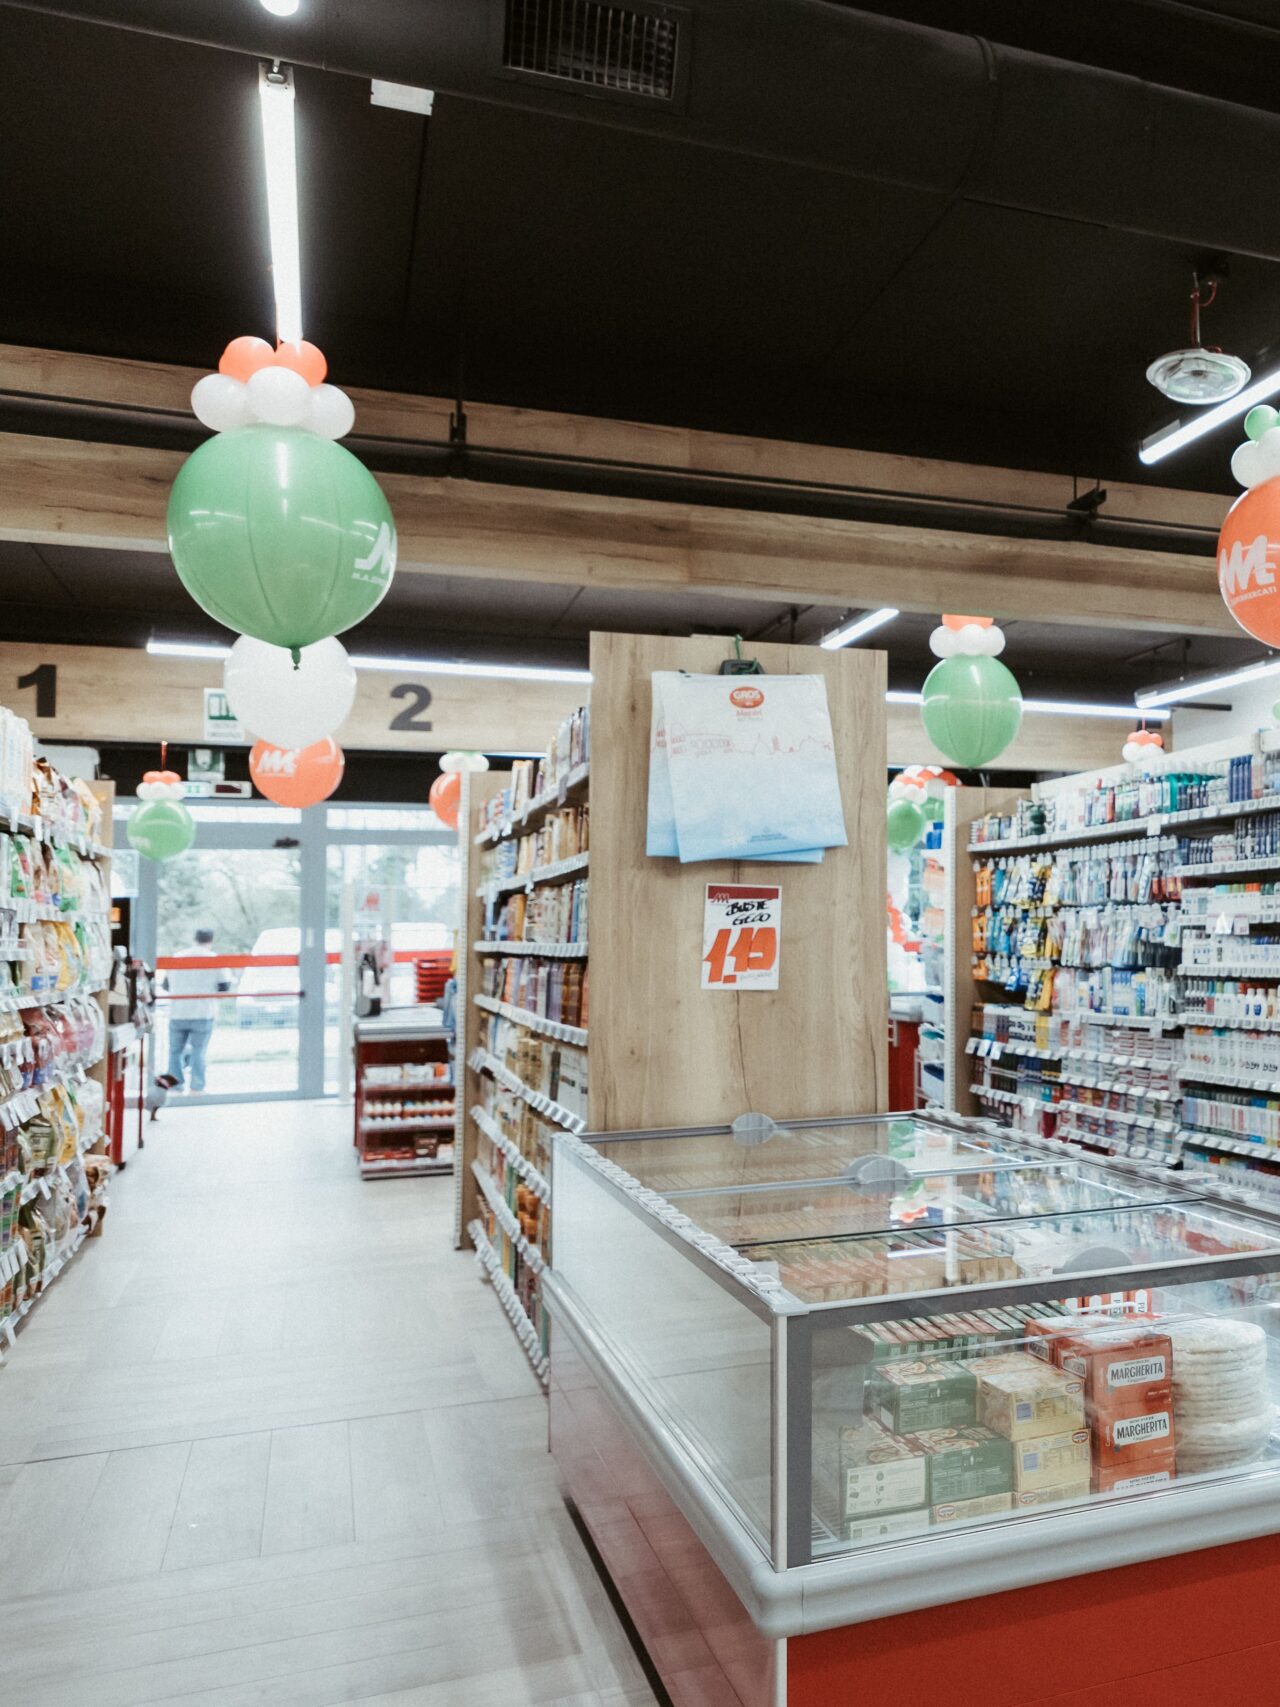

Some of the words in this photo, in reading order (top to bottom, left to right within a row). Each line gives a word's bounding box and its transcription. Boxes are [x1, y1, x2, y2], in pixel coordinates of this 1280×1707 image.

[17, 663, 58, 718] 1
[388, 684, 433, 732] 2
[1110, 1361, 1164, 1381] MARGHERITA
[1116, 1418, 1168, 1440] MARGHERITA
